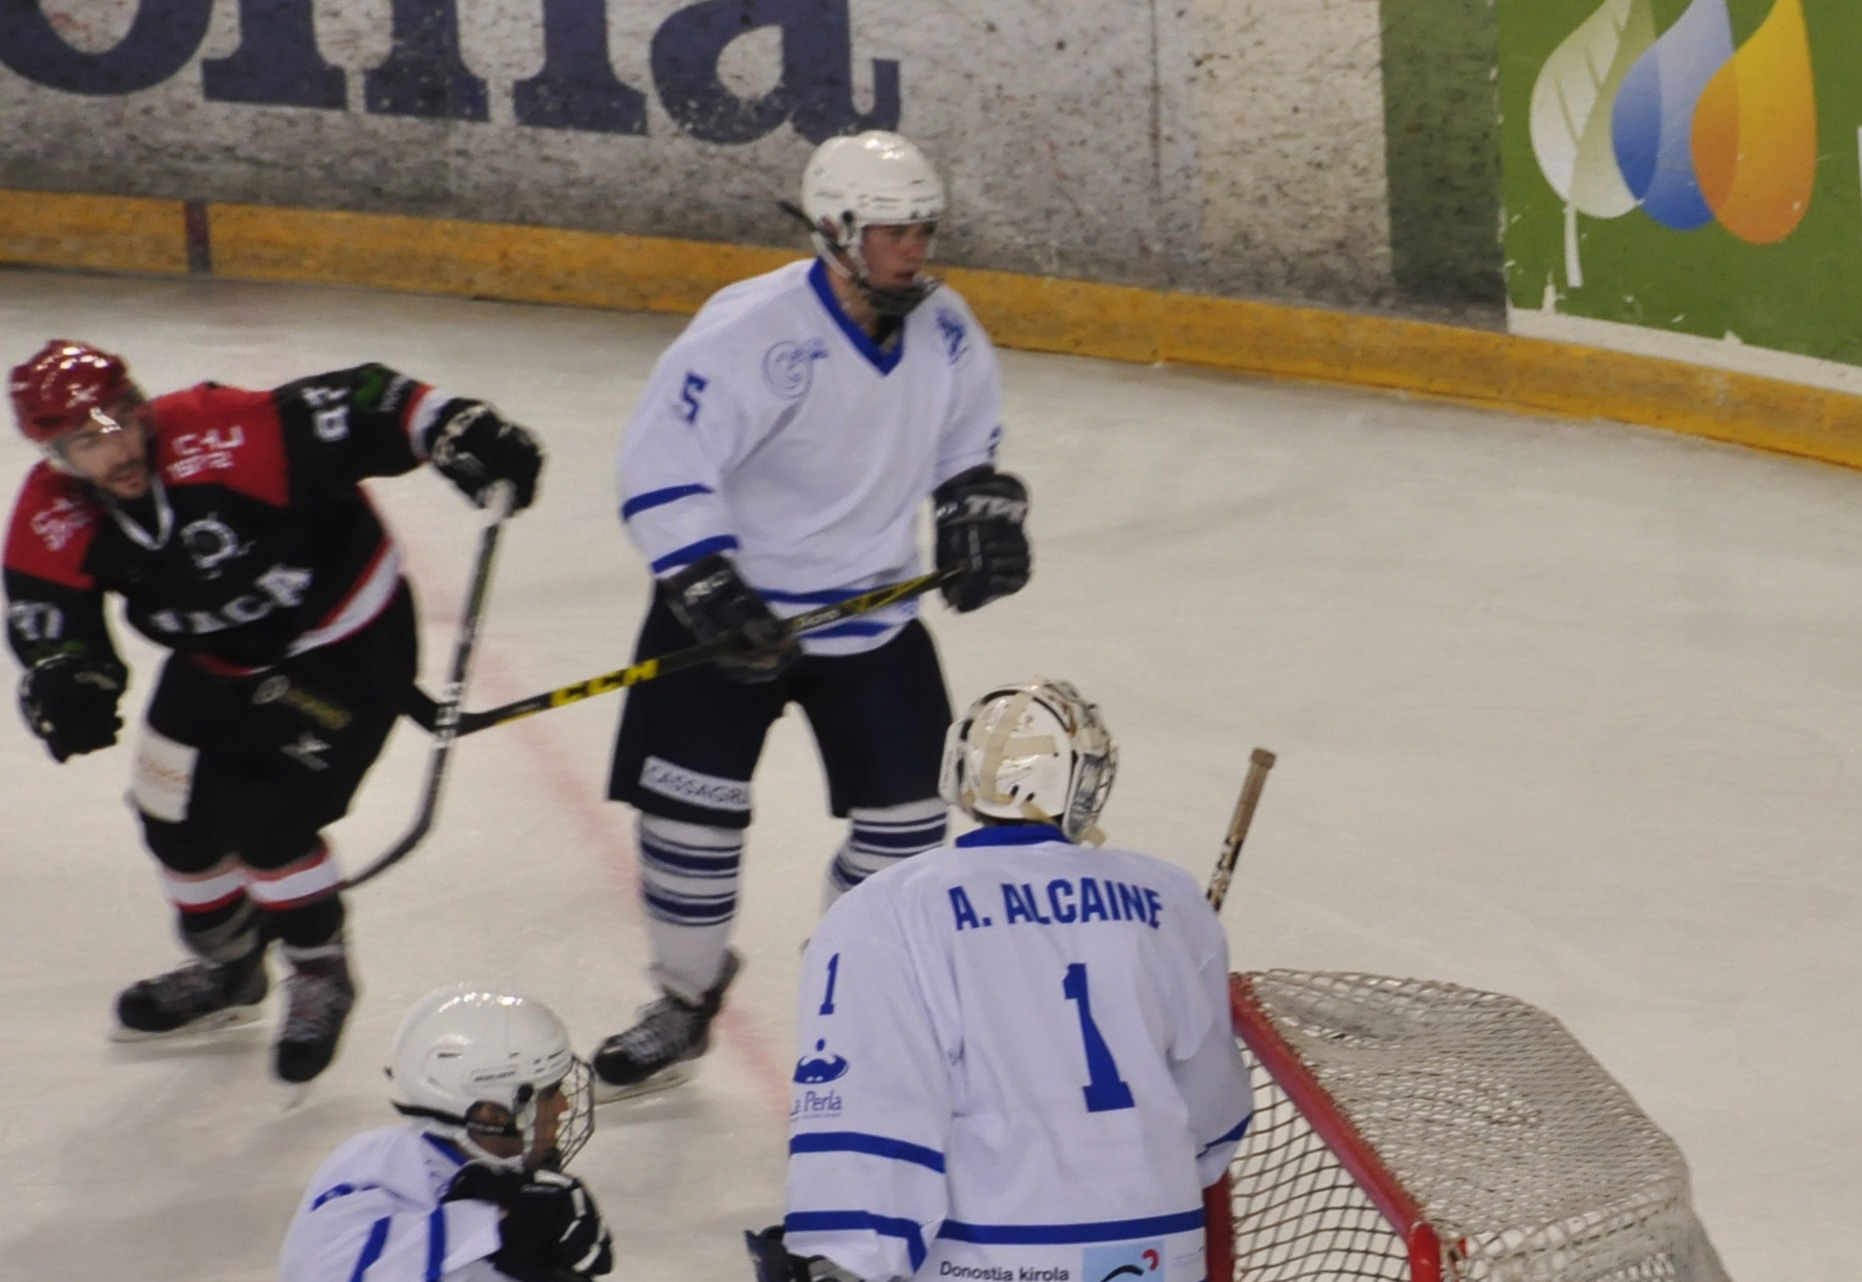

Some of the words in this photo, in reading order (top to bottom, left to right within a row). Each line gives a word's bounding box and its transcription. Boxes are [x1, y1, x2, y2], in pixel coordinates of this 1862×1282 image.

[680, 370, 710, 425] 5
[551, 659, 659, 708] CCM
[948, 885, 992, 931] A.
[1001, 877, 1163, 930] ALCAINE
[819, 953, 840, 1016] 1
[1062, 962, 1136, 1113] 1
[804, 1089, 842, 1112] Perla
[939, 1260, 1014, 1282] Donostia
[1018, 1266, 1070, 1282] kirola
